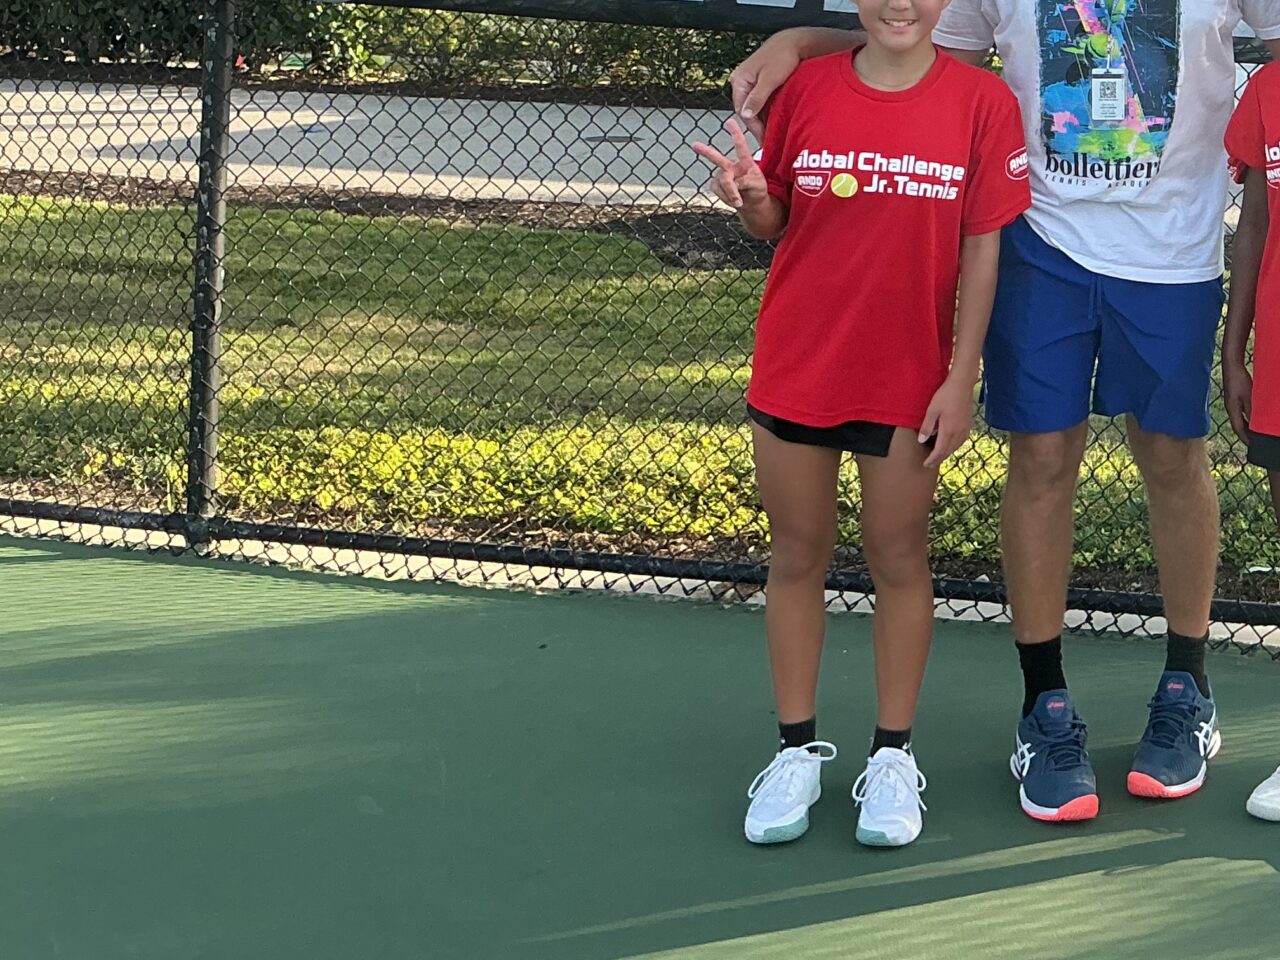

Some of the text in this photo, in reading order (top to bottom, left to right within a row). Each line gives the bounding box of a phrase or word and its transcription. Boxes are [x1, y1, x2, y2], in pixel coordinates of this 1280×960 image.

[857, 152, 965, 181] Challenge
[1044, 173, 1087, 186] TENNIS
[863, 174, 958, 200] Jr.Tennis
